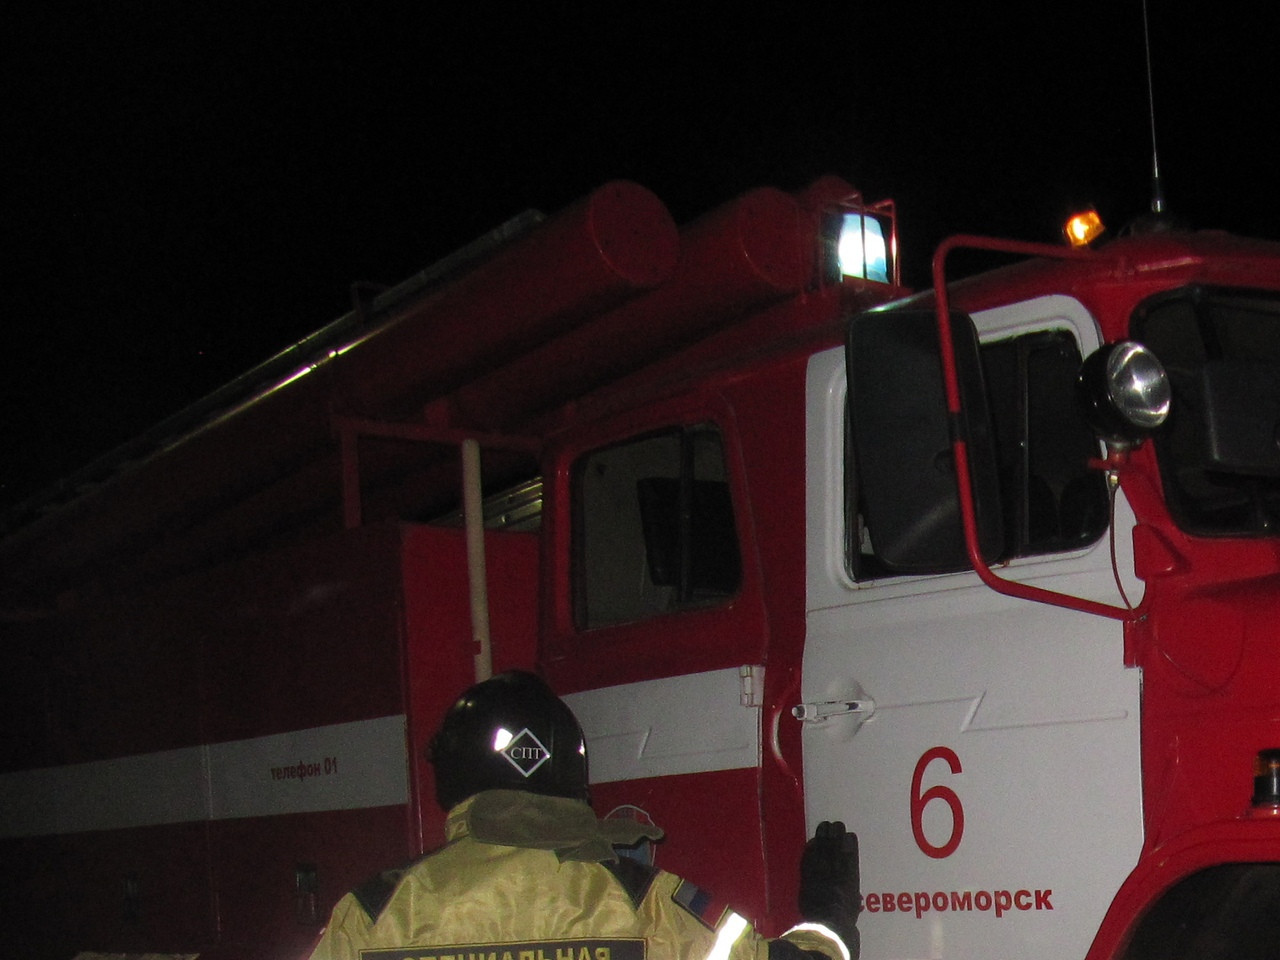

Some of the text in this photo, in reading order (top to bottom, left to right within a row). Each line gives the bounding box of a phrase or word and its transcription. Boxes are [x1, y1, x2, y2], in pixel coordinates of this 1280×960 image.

[510, 746, 542, 760] СПТ
[271, 757, 337, 782] телефон 01
[910, 746, 965, 860] 6
[859, 889, 1054, 919] евероморск
